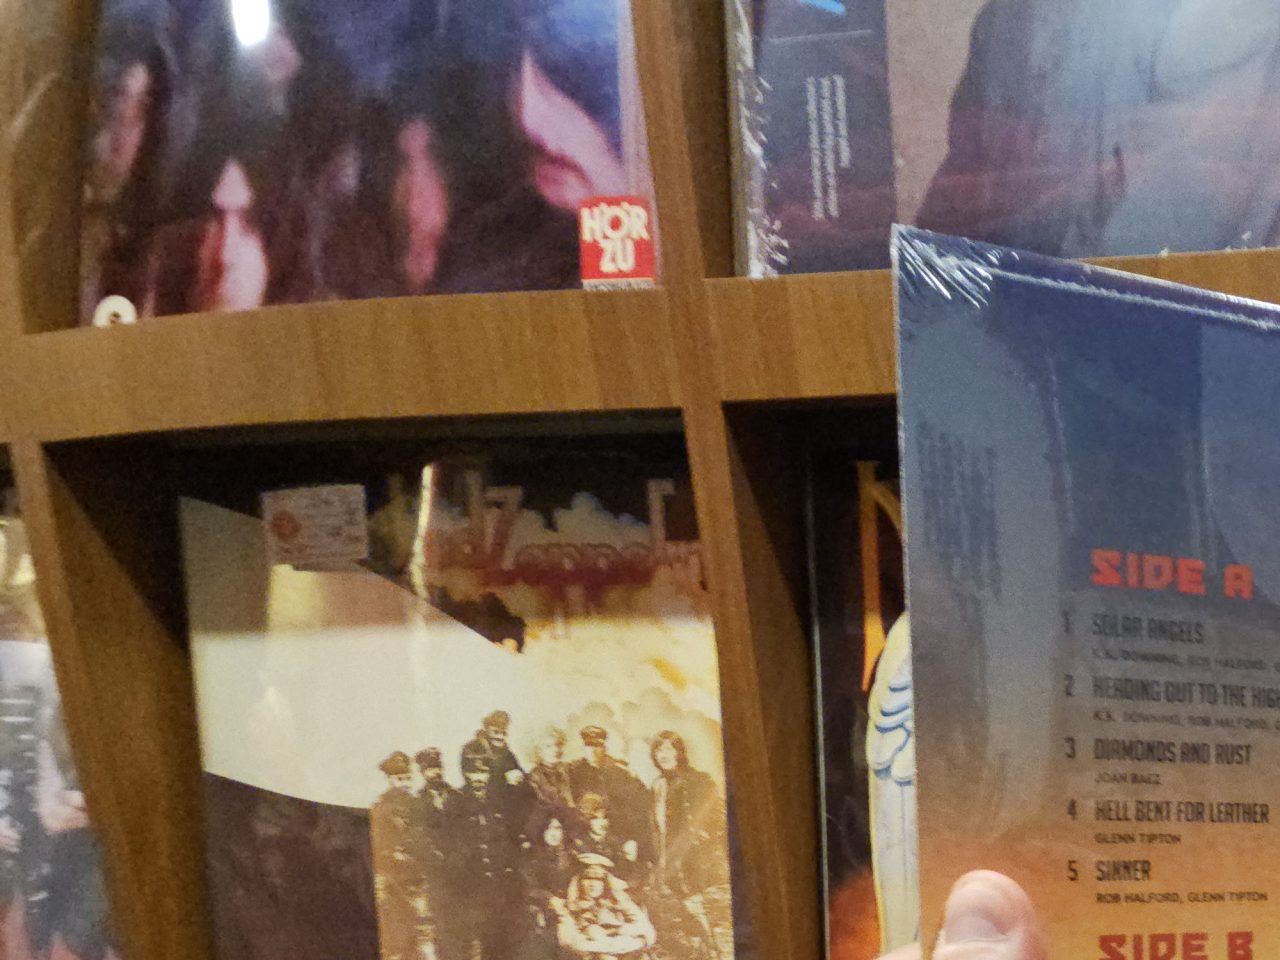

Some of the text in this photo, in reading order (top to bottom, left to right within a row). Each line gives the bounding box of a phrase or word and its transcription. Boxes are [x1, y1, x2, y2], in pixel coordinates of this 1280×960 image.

[599, 239, 636, 273] ZU
[1090, 548, 1255, 600] SIDE A
[1062, 611, 1071, 634] 1
[1092, 613, 1143, 640] SOLAR
[1149, 617, 1204, 644] ANGELS
[1064, 674, 1075, 698] 2
[1092, 675, 1162, 702] HEADING
[1164, 679, 1196, 704] OUT
[1198, 681, 1219, 706] TO
[1222, 684, 1248, 709] THE
[1064, 737, 1076, 760] 3
[1093, 737, 1177, 764] DIAMONDS
[1180, 741, 1211, 765] AND
[1215, 743, 1251, 766] RUST
[1066, 799, 1078, 822] 4
[1095, 800, 1131, 823] HELL
[1134, 800, 1175, 823] BENT
[1177, 801, 1205, 824] FOR
[1208, 802, 1270, 825] LEATHER
[1067, 859, 1079, 882] 5
[1095, 859, 1152, 882] SINNER
